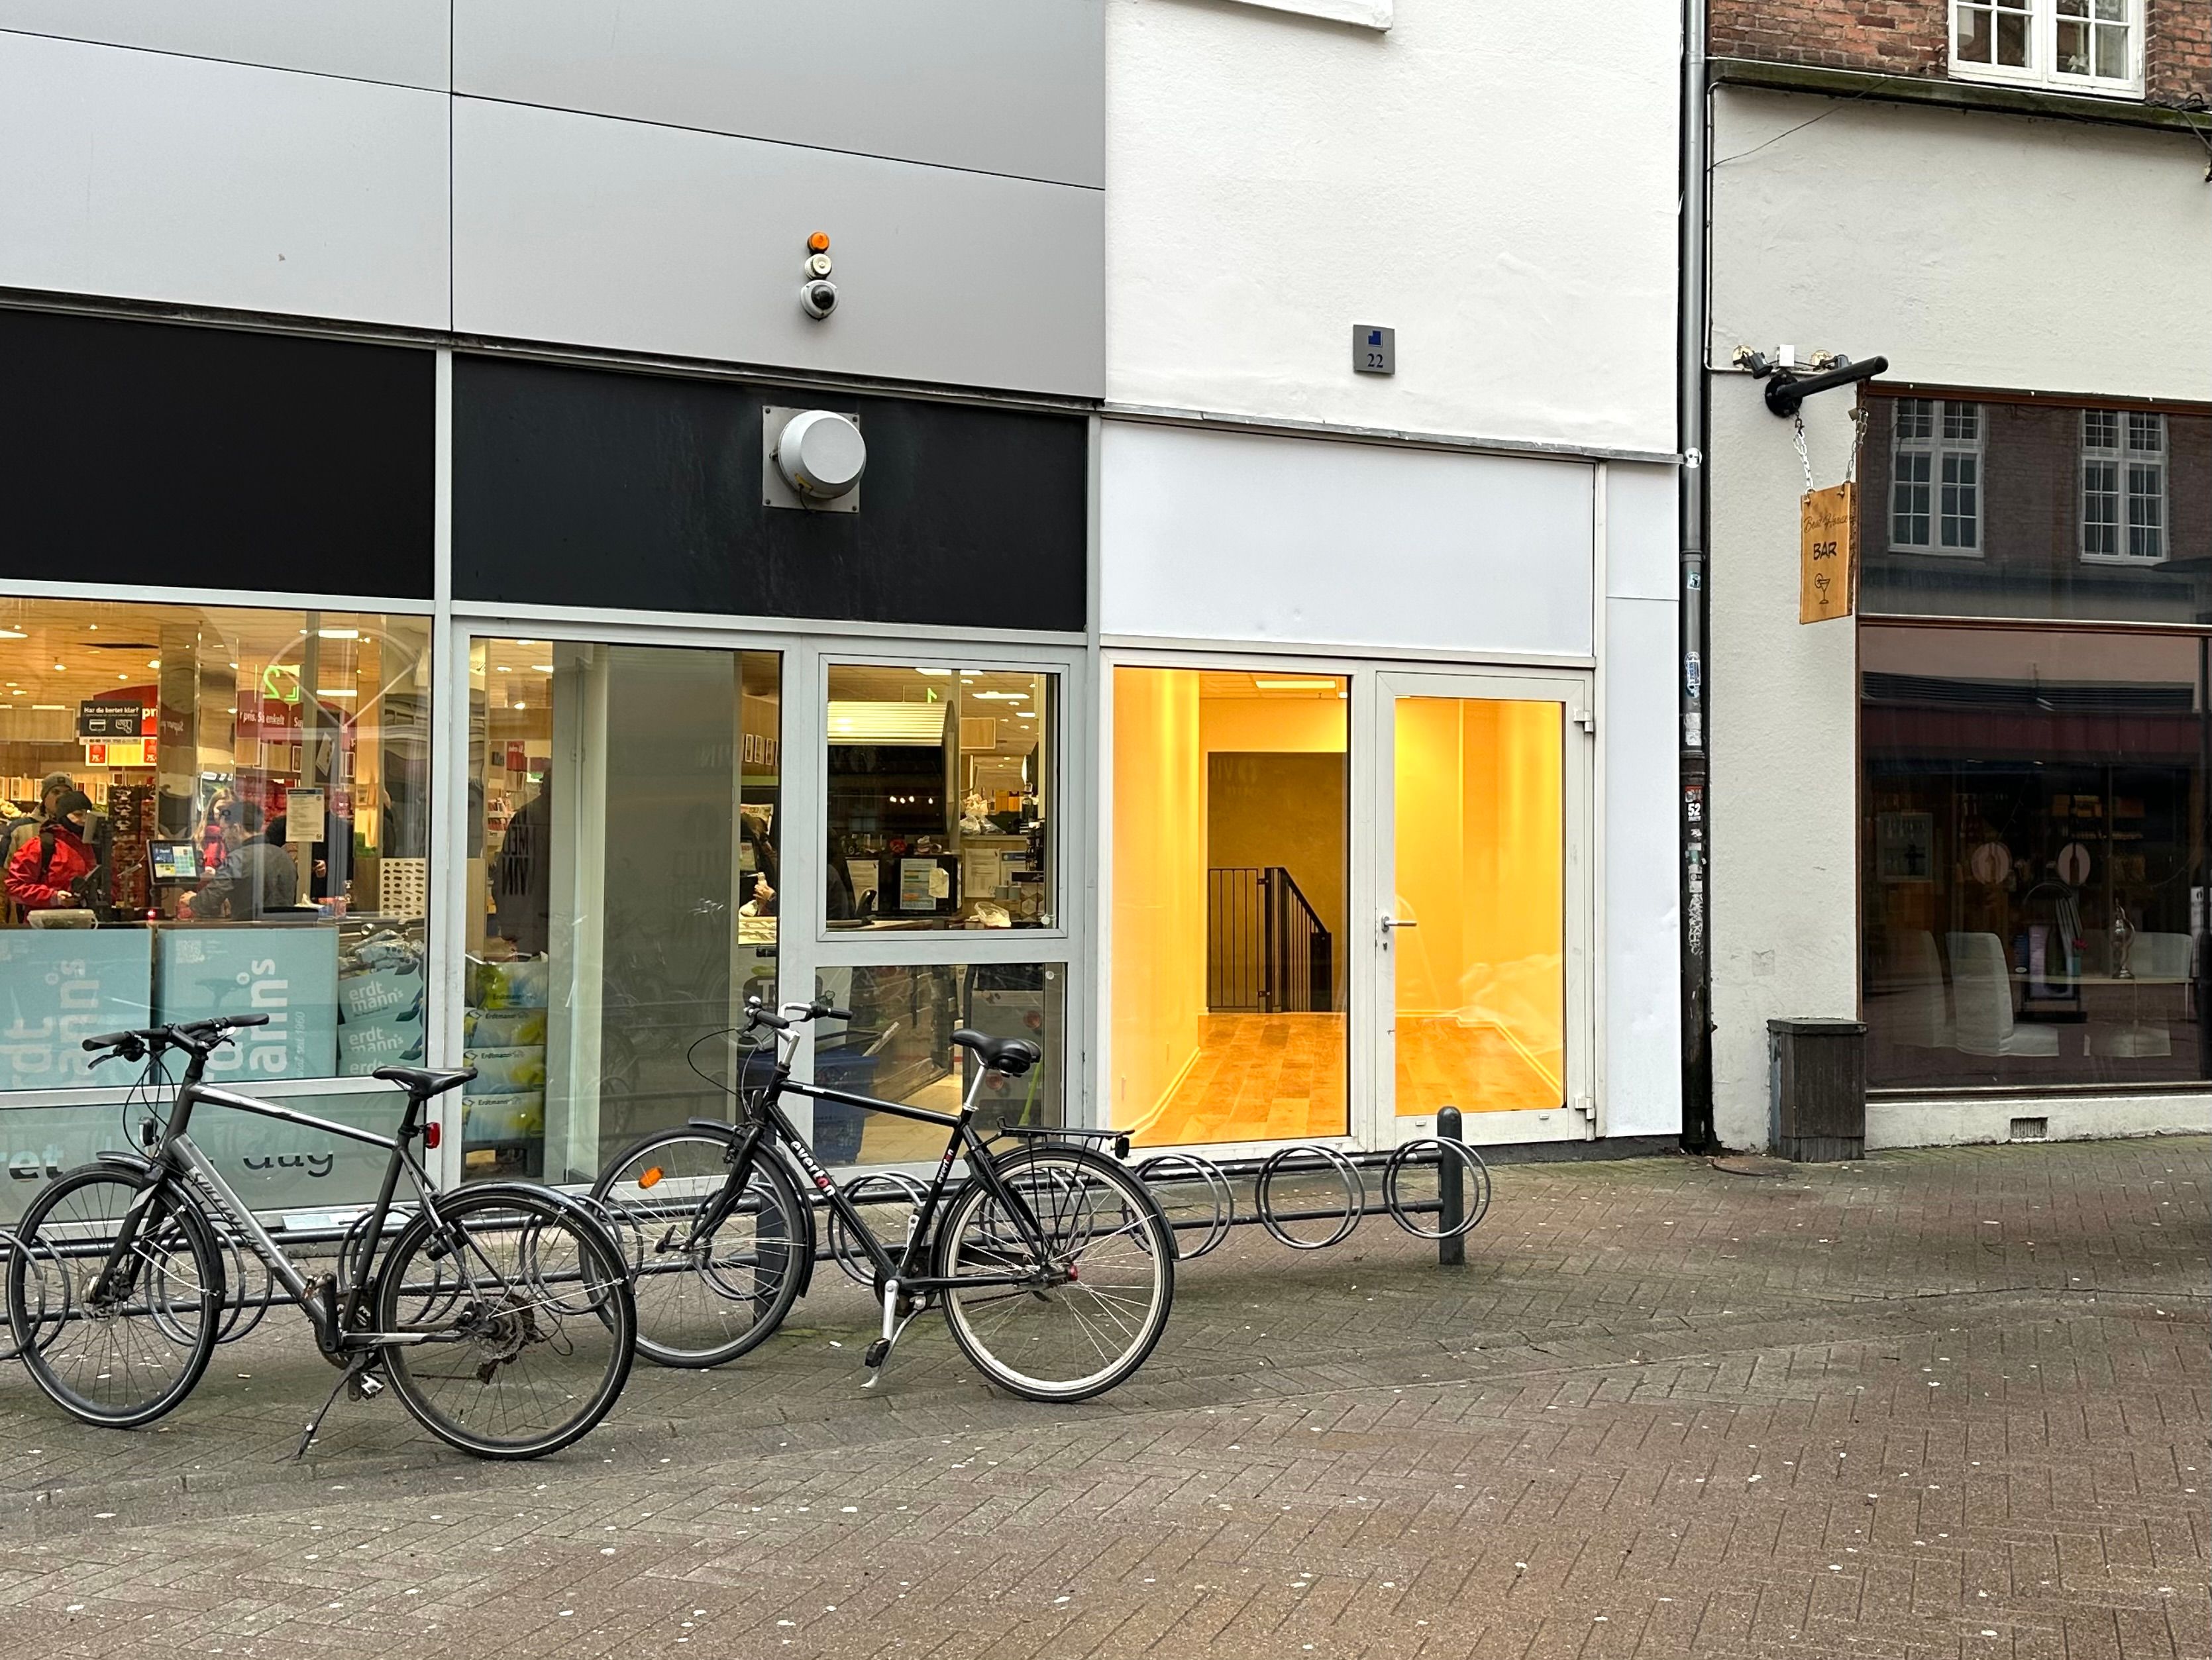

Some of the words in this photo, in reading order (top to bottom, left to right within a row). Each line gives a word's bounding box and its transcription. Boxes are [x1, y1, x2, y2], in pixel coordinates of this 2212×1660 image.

[1367, 353, 1383, 368] 22
[1813, 541, 1837, 560] BAR
[1688, 803, 1701, 817] 52
[349, 980, 385, 1000] erdt
[349, 1026, 385, 1045] erdt
[790, 1141, 836, 1197] everton
[937, 1149, 954, 1184] everton
